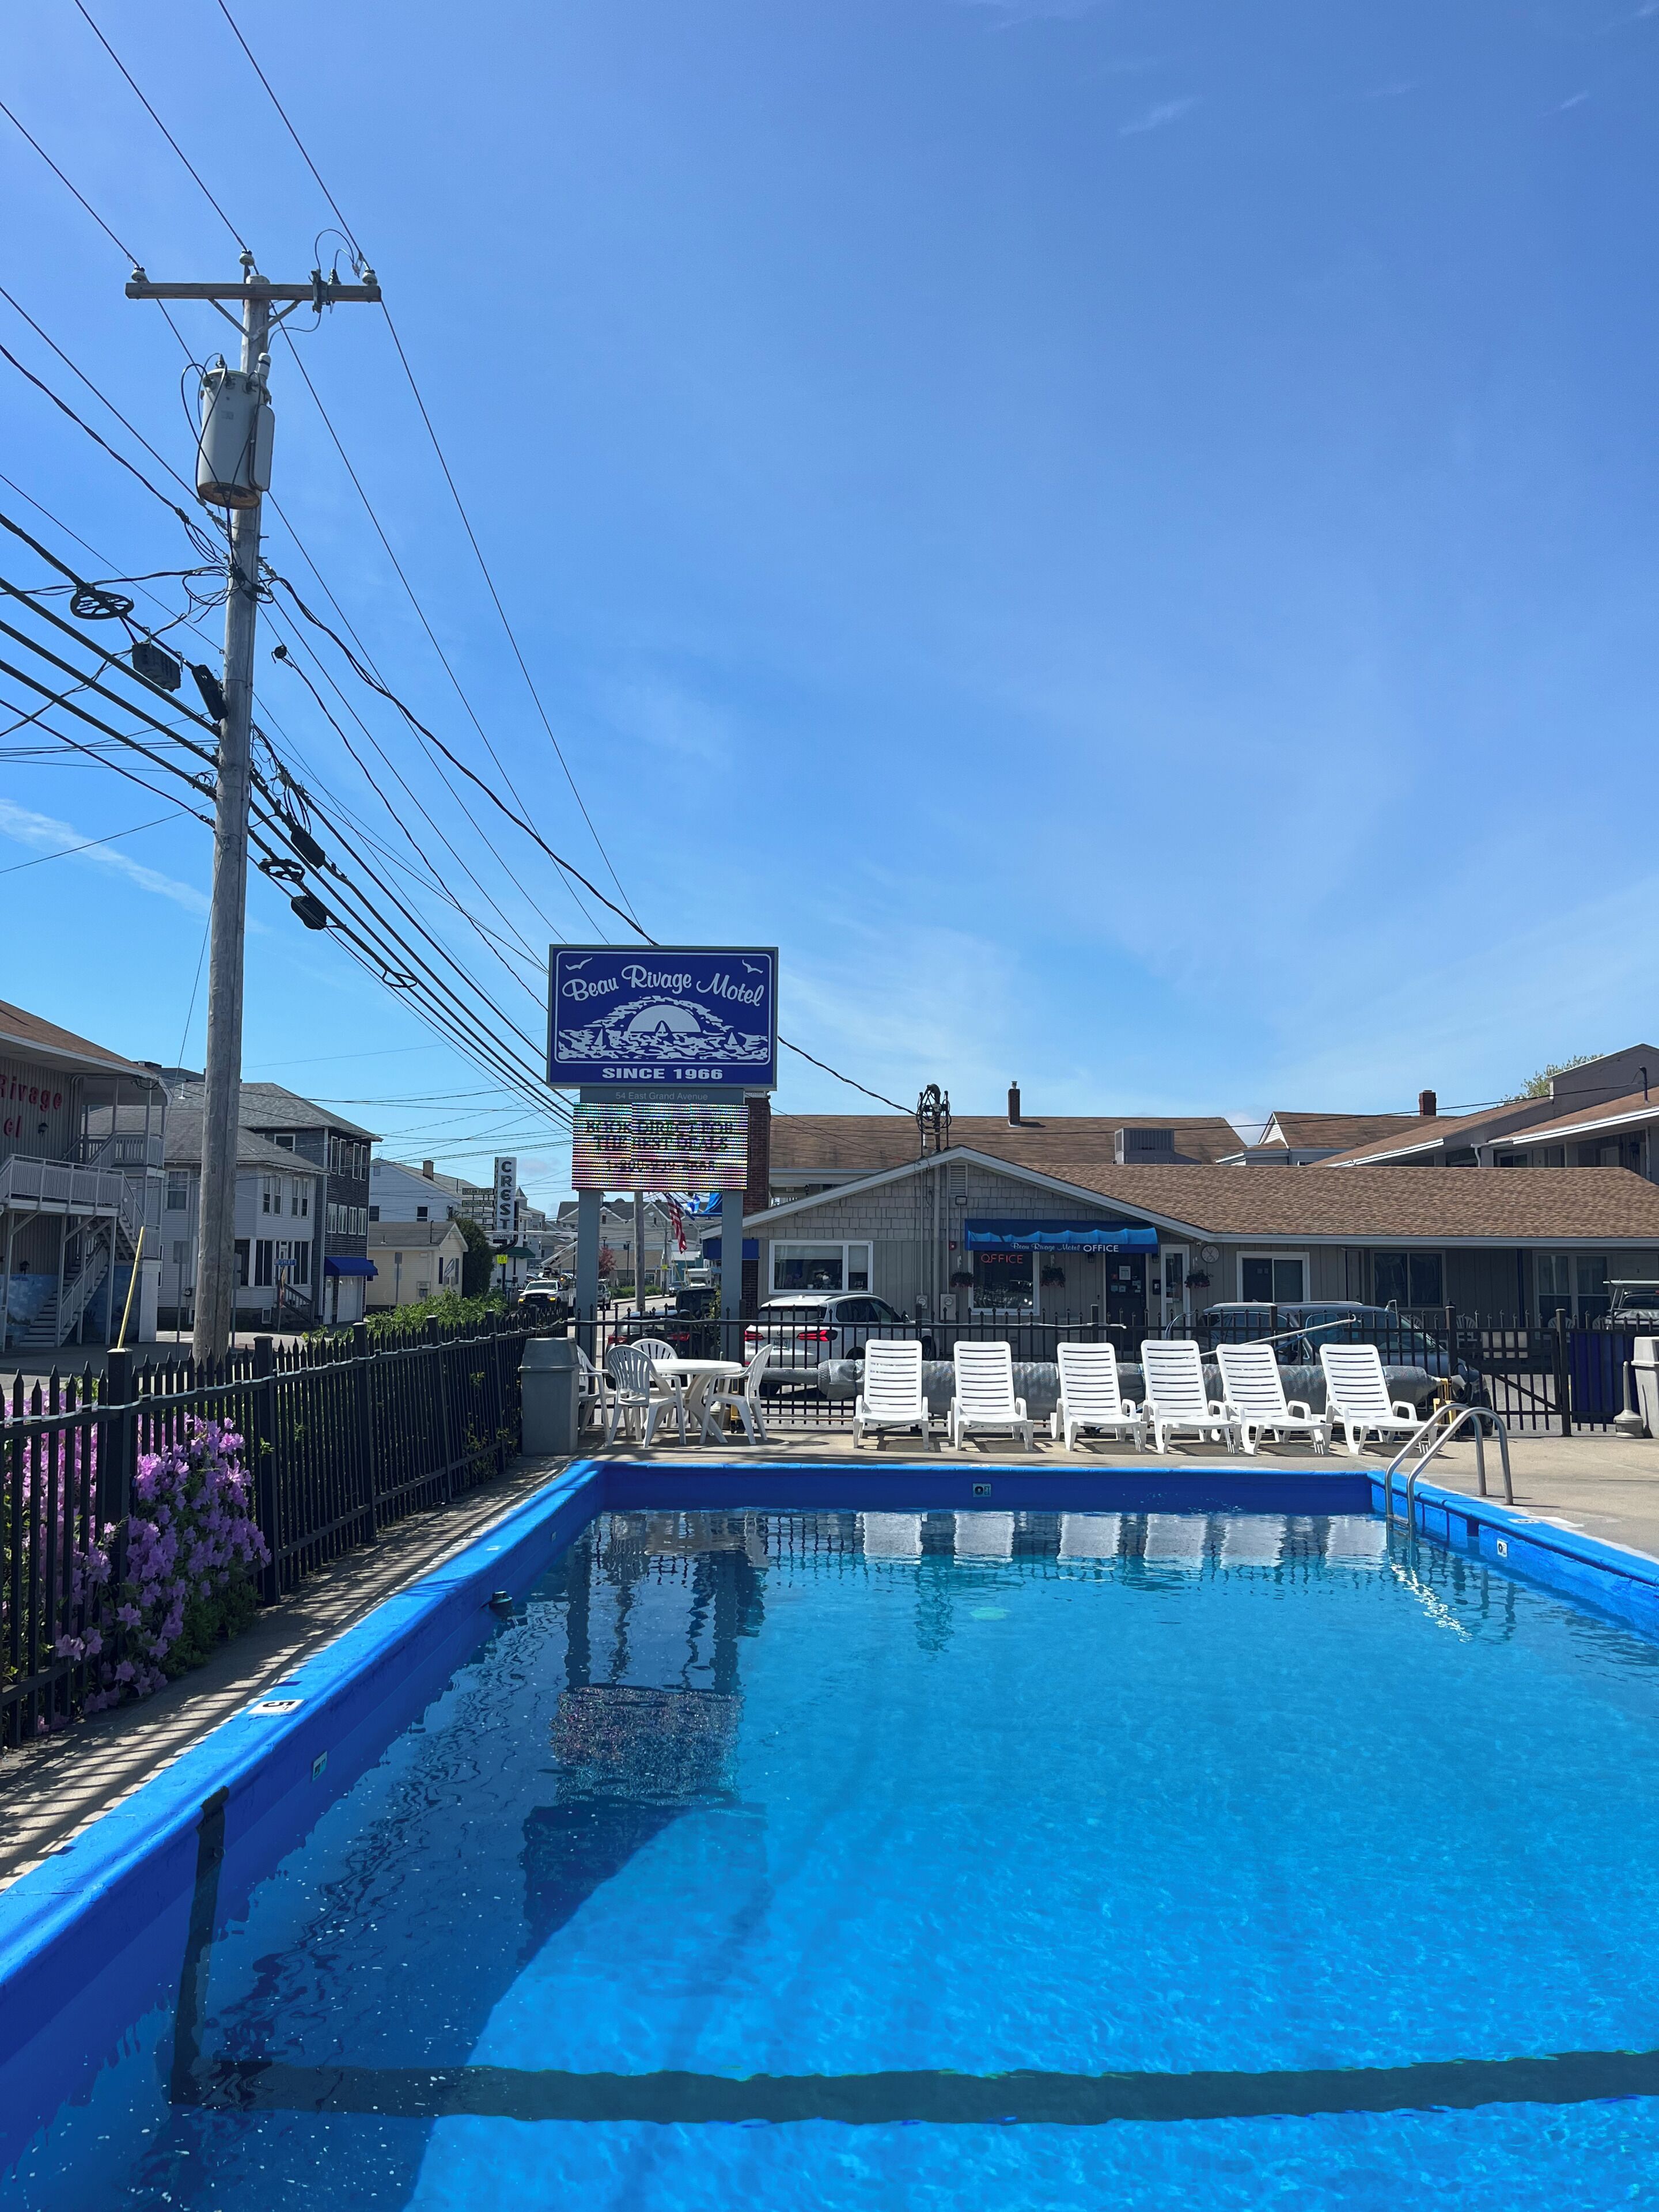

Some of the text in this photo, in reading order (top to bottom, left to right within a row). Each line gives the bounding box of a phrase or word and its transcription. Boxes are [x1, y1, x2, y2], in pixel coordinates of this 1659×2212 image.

[562, 965, 764, 1006] Beau Rivage Motel
[602, 1068, 723, 1080] SINCE 1966
[500, 1161, 512, 1229] CREST
[1031, 1243, 1055, 1252] Rivage
[1058, 1244, 1081, 1252] Motel
[1083, 1244, 1119, 1252] OFFICE
[981, 1253, 1024, 1264] OFFICE
